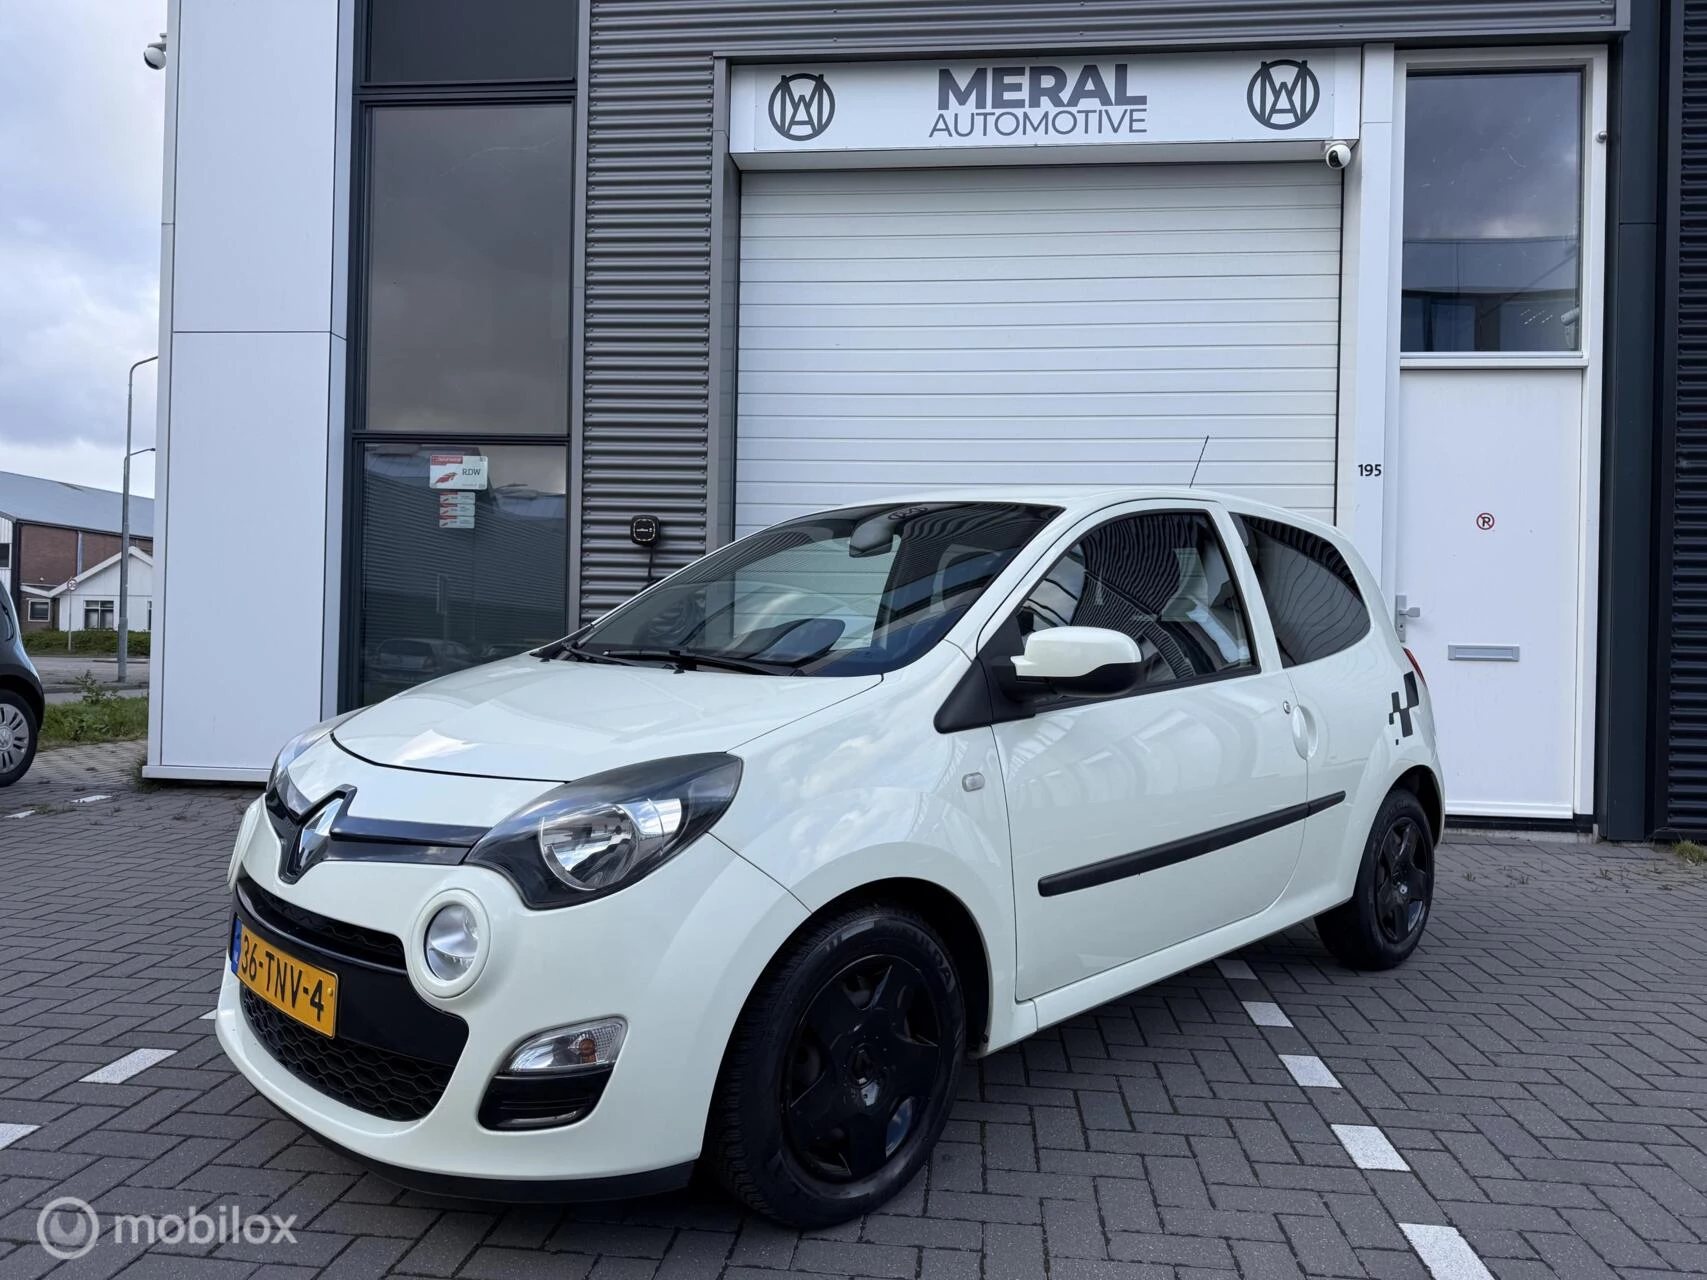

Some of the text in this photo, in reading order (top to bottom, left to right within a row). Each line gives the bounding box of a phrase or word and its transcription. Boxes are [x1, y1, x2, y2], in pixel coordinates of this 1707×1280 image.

[938, 63, 1147, 110] MERAL
[929, 108, 1147, 138] AUTOMOTIVE
[462, 468, 481, 476] RDW
[1358, 463, 1382, 477] 195
[241, 934, 324, 1022] 36-TNV-4
